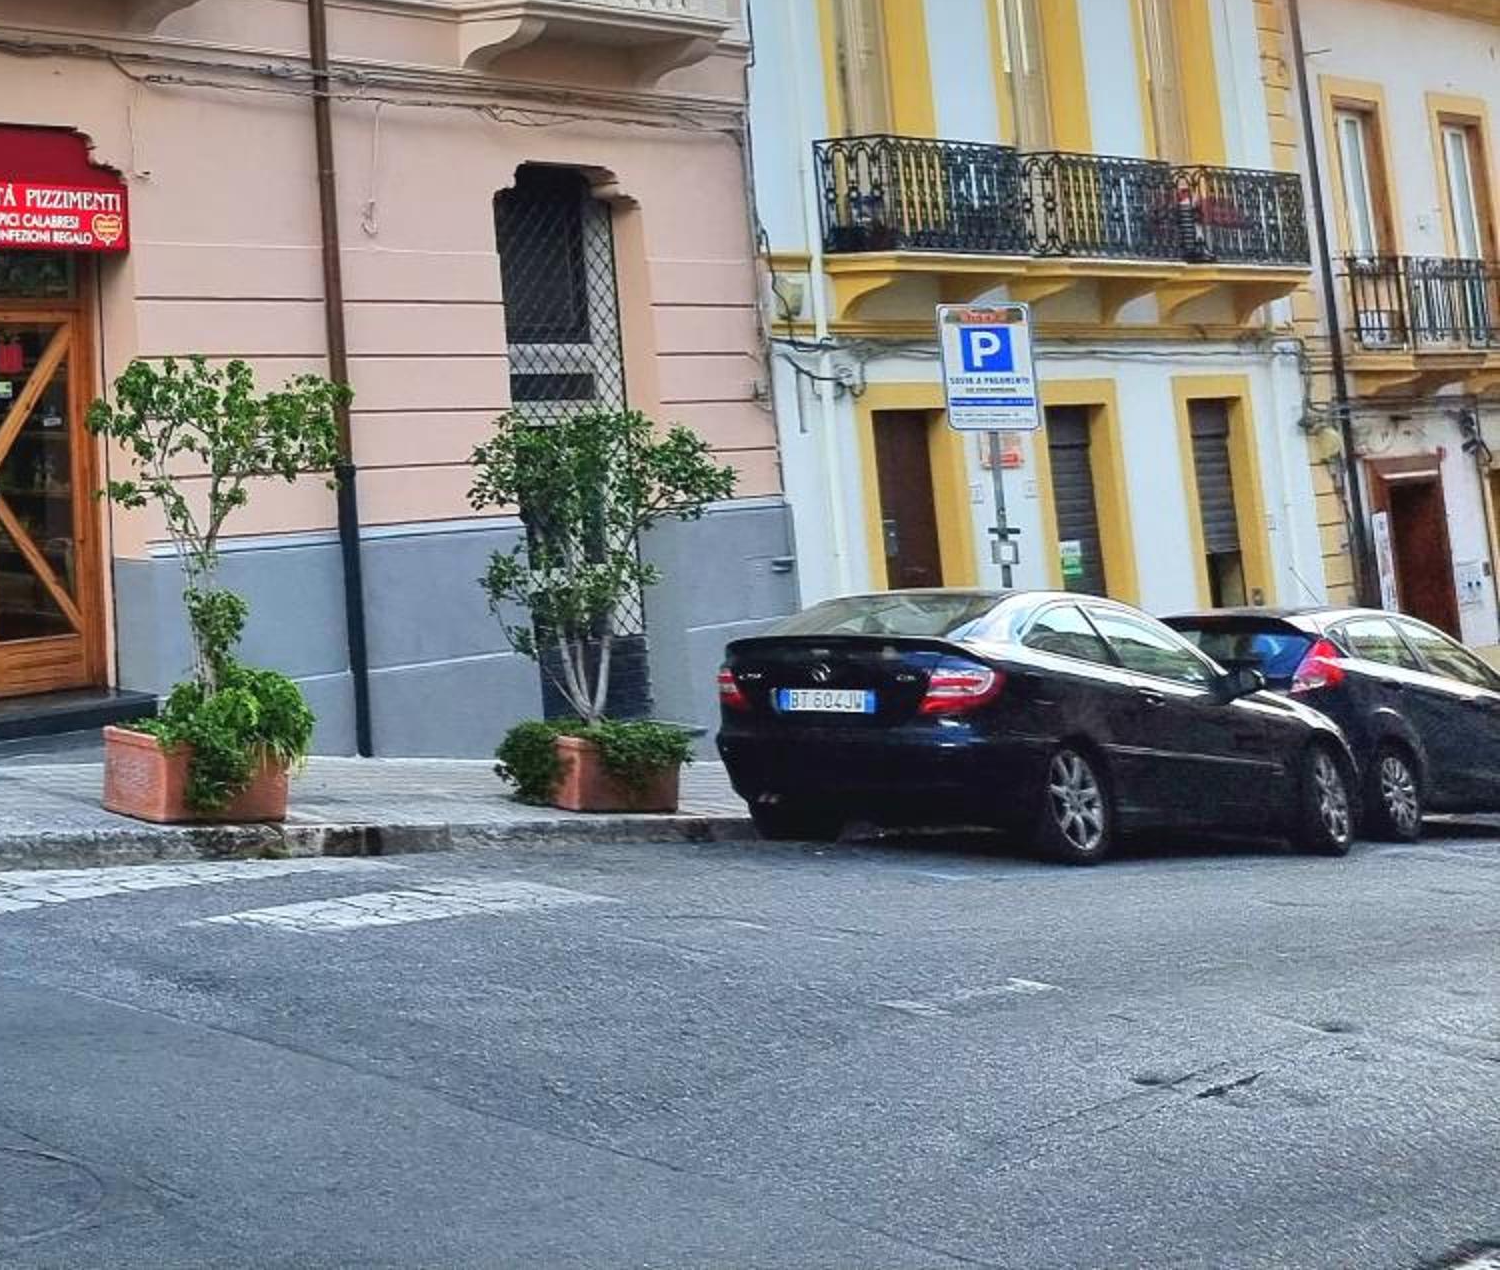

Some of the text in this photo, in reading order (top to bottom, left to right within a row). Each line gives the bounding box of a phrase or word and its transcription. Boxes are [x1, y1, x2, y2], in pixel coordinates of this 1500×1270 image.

[25, 189, 121, 212] PIZZIMENTI
[22, 213, 79, 229] CALABRESI
[51, 231, 93, 245] REGALO
[970, 331, 1001, 368] P
